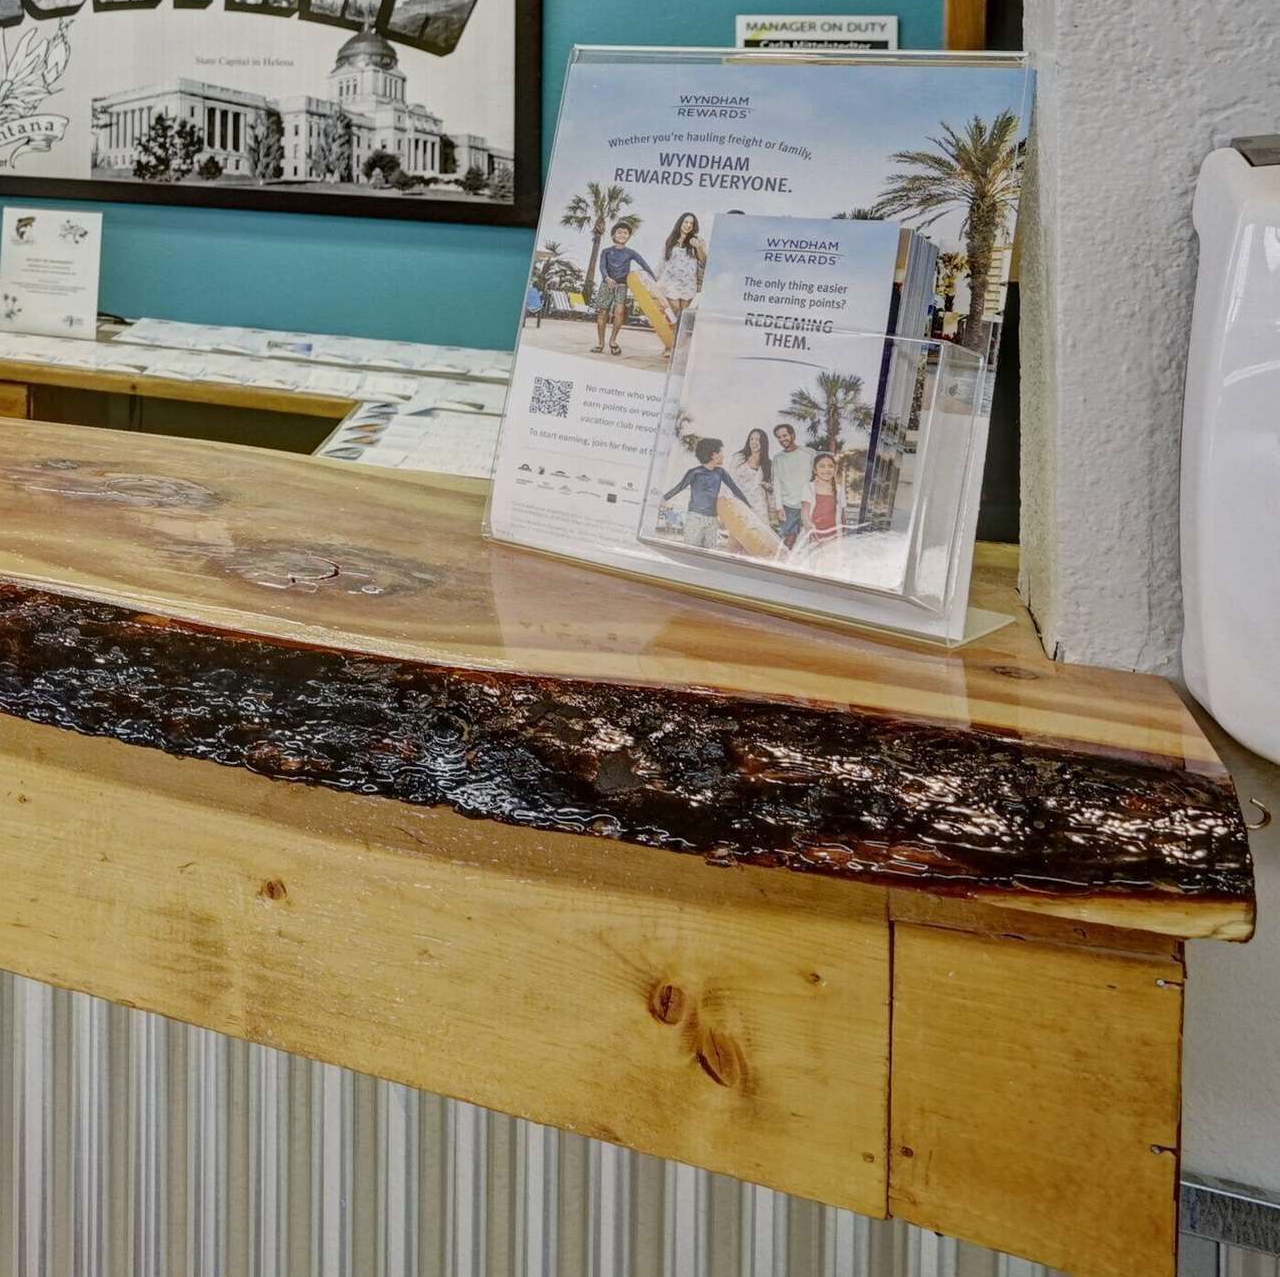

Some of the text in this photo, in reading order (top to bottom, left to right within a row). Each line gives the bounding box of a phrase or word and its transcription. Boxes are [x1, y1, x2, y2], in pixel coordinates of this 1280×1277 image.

[745, 21, 888, 33] MANAGER ON DUTY
[679, 94, 750, 107] WYNDHAM
[608, 131, 813, 161] Whether you're hauling freight or family,
[658, 152, 750, 172] WYNDHAM
[613, 167, 793, 194] REWARDS EVERYONE.
[767, 237, 839, 251] WYNDHAM
[744, 276, 848, 295] The only thing easier
[743, 291, 847, 310] than earning points?
[744, 312, 834, 334] REDEEMING
[764, 332, 812, 351] THEM.
[585, 384, 598, 393] No
[598, 386, 626, 397] matter
[626, 390, 644, 400] who
[645, 393, 662, 403] you
[582, 400, 602, 410] earn
[602, 402, 628, 414] points
[628, 407, 640, 415] on
[640, 409, 661, 419] your
[580, 415, 615, 427] vacation
[615, 420, 634, 430] club
[529, 427, 539, 437] To
[539, 429, 557, 440] start
[591, 438, 608, 448] join
[608, 440, 621, 450] for
[622, 442, 638, 453] free
[639, 447, 648, 456] at
